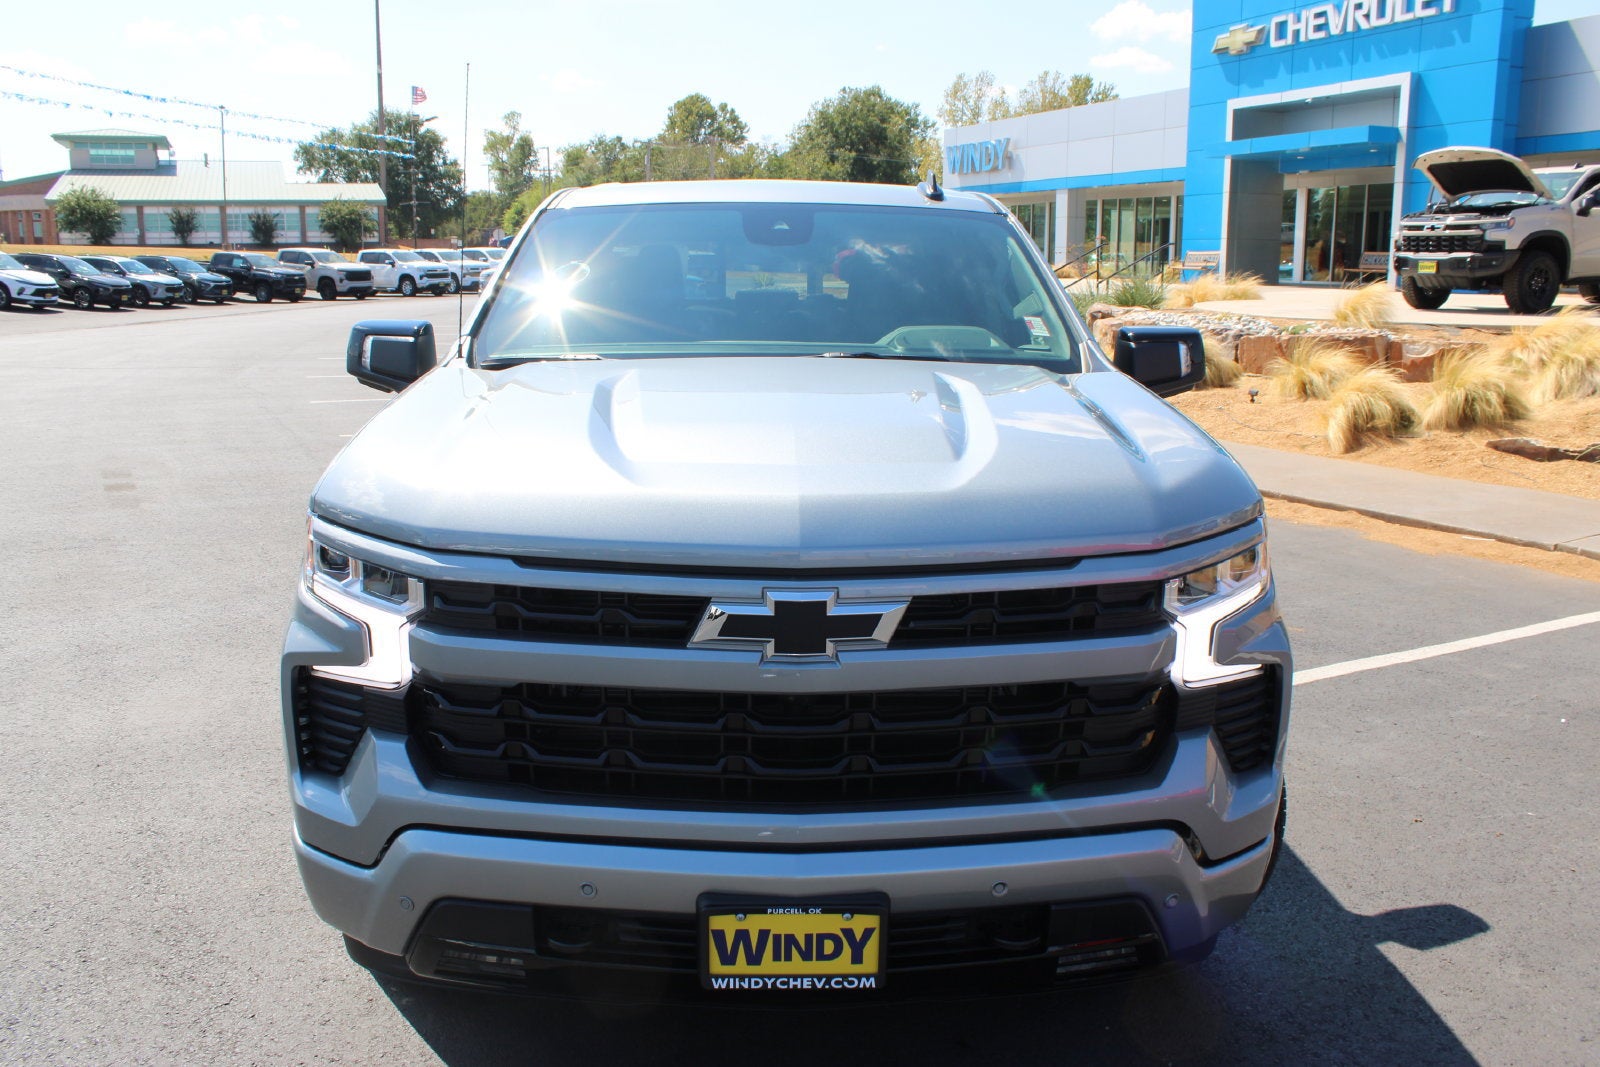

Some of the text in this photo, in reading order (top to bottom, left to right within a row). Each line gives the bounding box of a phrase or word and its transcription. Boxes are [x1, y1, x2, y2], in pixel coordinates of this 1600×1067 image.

[946, 138, 1011, 175] WINDY
[711, 927, 877, 966] WINDY
[711, 977, 876, 989] WINDYCHEV.COM
